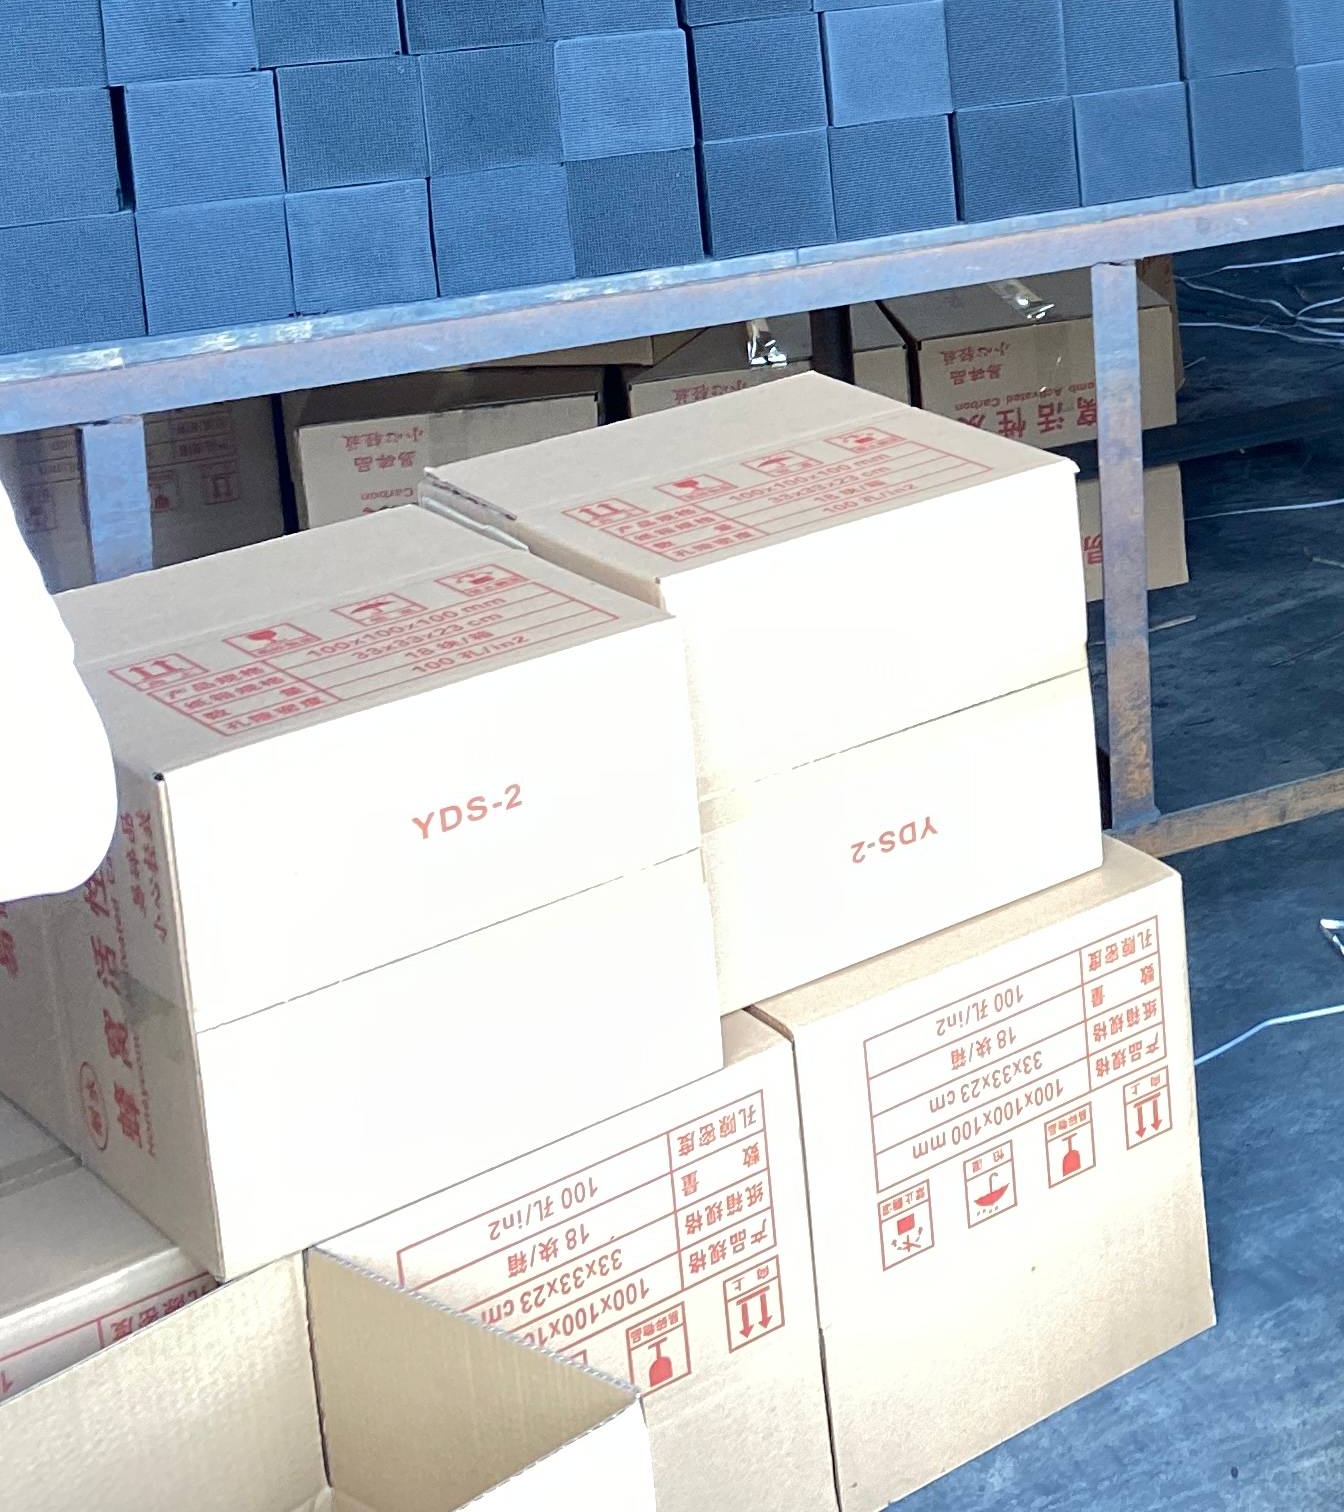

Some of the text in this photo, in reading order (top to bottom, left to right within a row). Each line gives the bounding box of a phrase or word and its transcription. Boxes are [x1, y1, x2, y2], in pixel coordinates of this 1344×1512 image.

[410, 783, 524, 841] YDS-2
[850, 814, 939, 865] YDS-2
[994, 985, 1024, 1012] 100
[929, 1089, 956, 1113] cm
[960, 1051, 1043, 1102] 33x33x23
[951, 1079, 1064, 1138] 100x100x100
[912, 1131, 946, 1160] mm
[560, 1177, 598, 1210] 100
[520, 1248, 623, 1313] 33x33x23
